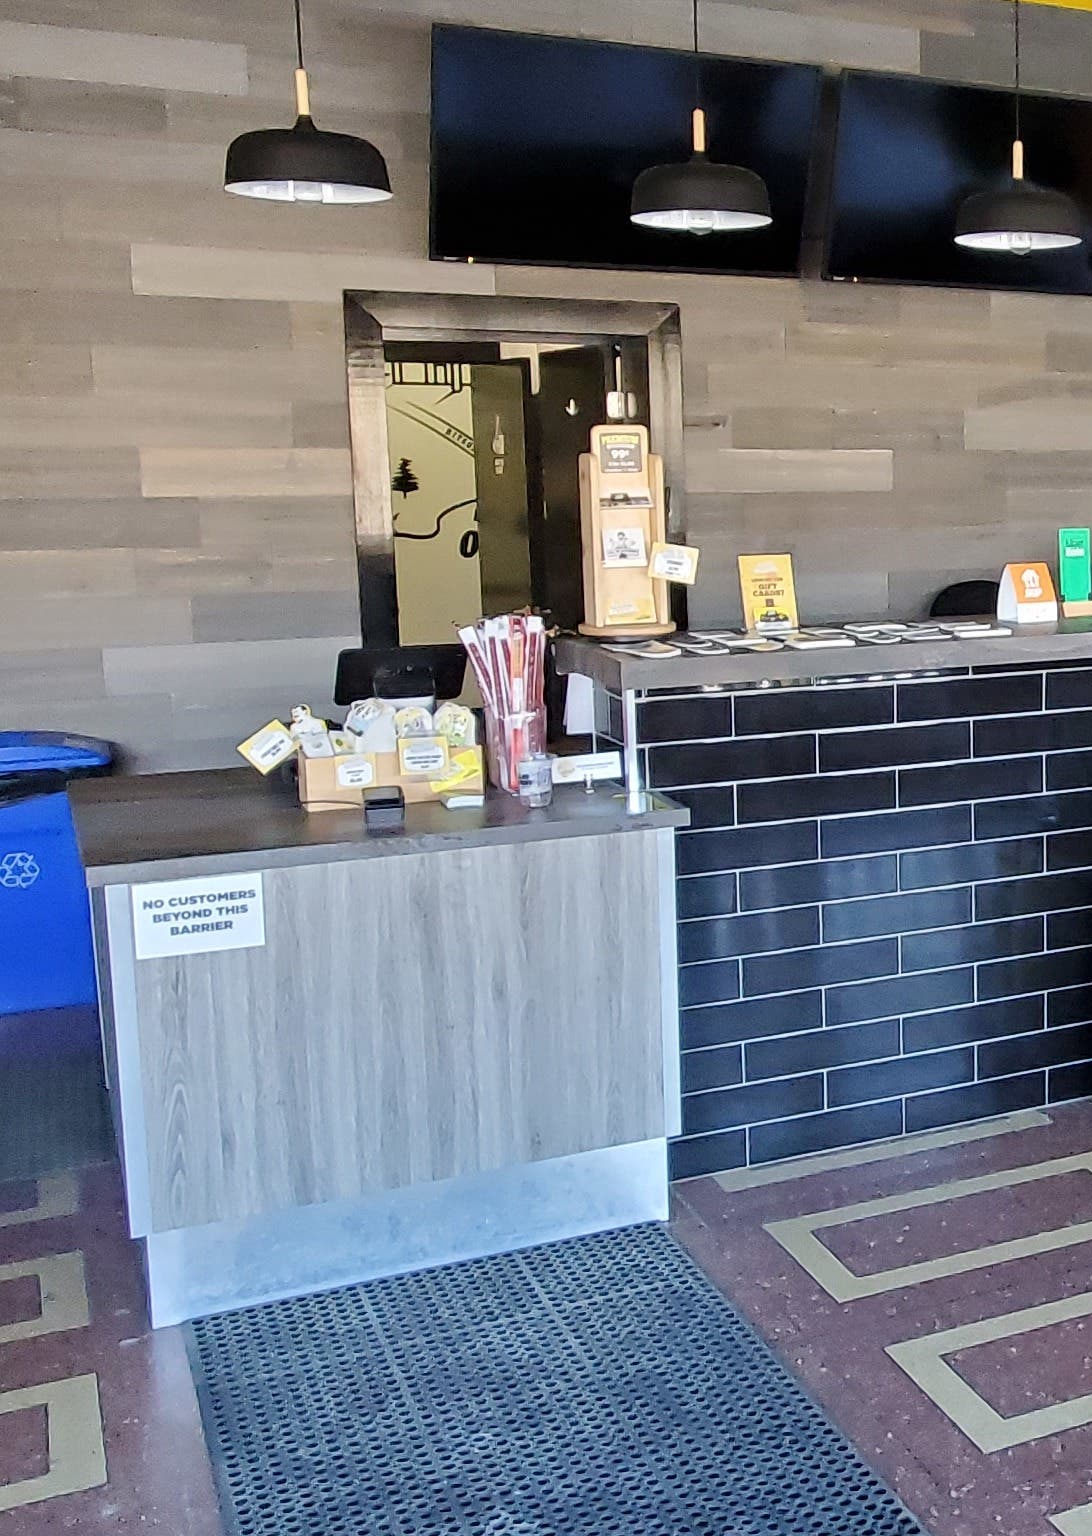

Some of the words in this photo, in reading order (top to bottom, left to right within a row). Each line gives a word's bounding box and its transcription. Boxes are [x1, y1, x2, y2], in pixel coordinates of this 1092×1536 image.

[142, 899, 164, 910] NO
[168, 889, 256, 907] CUSTOMERS
[152, 908, 212, 923] BEYOND
[216, 904, 248, 916] THIS
[170, 920, 233, 936] BARRIER
